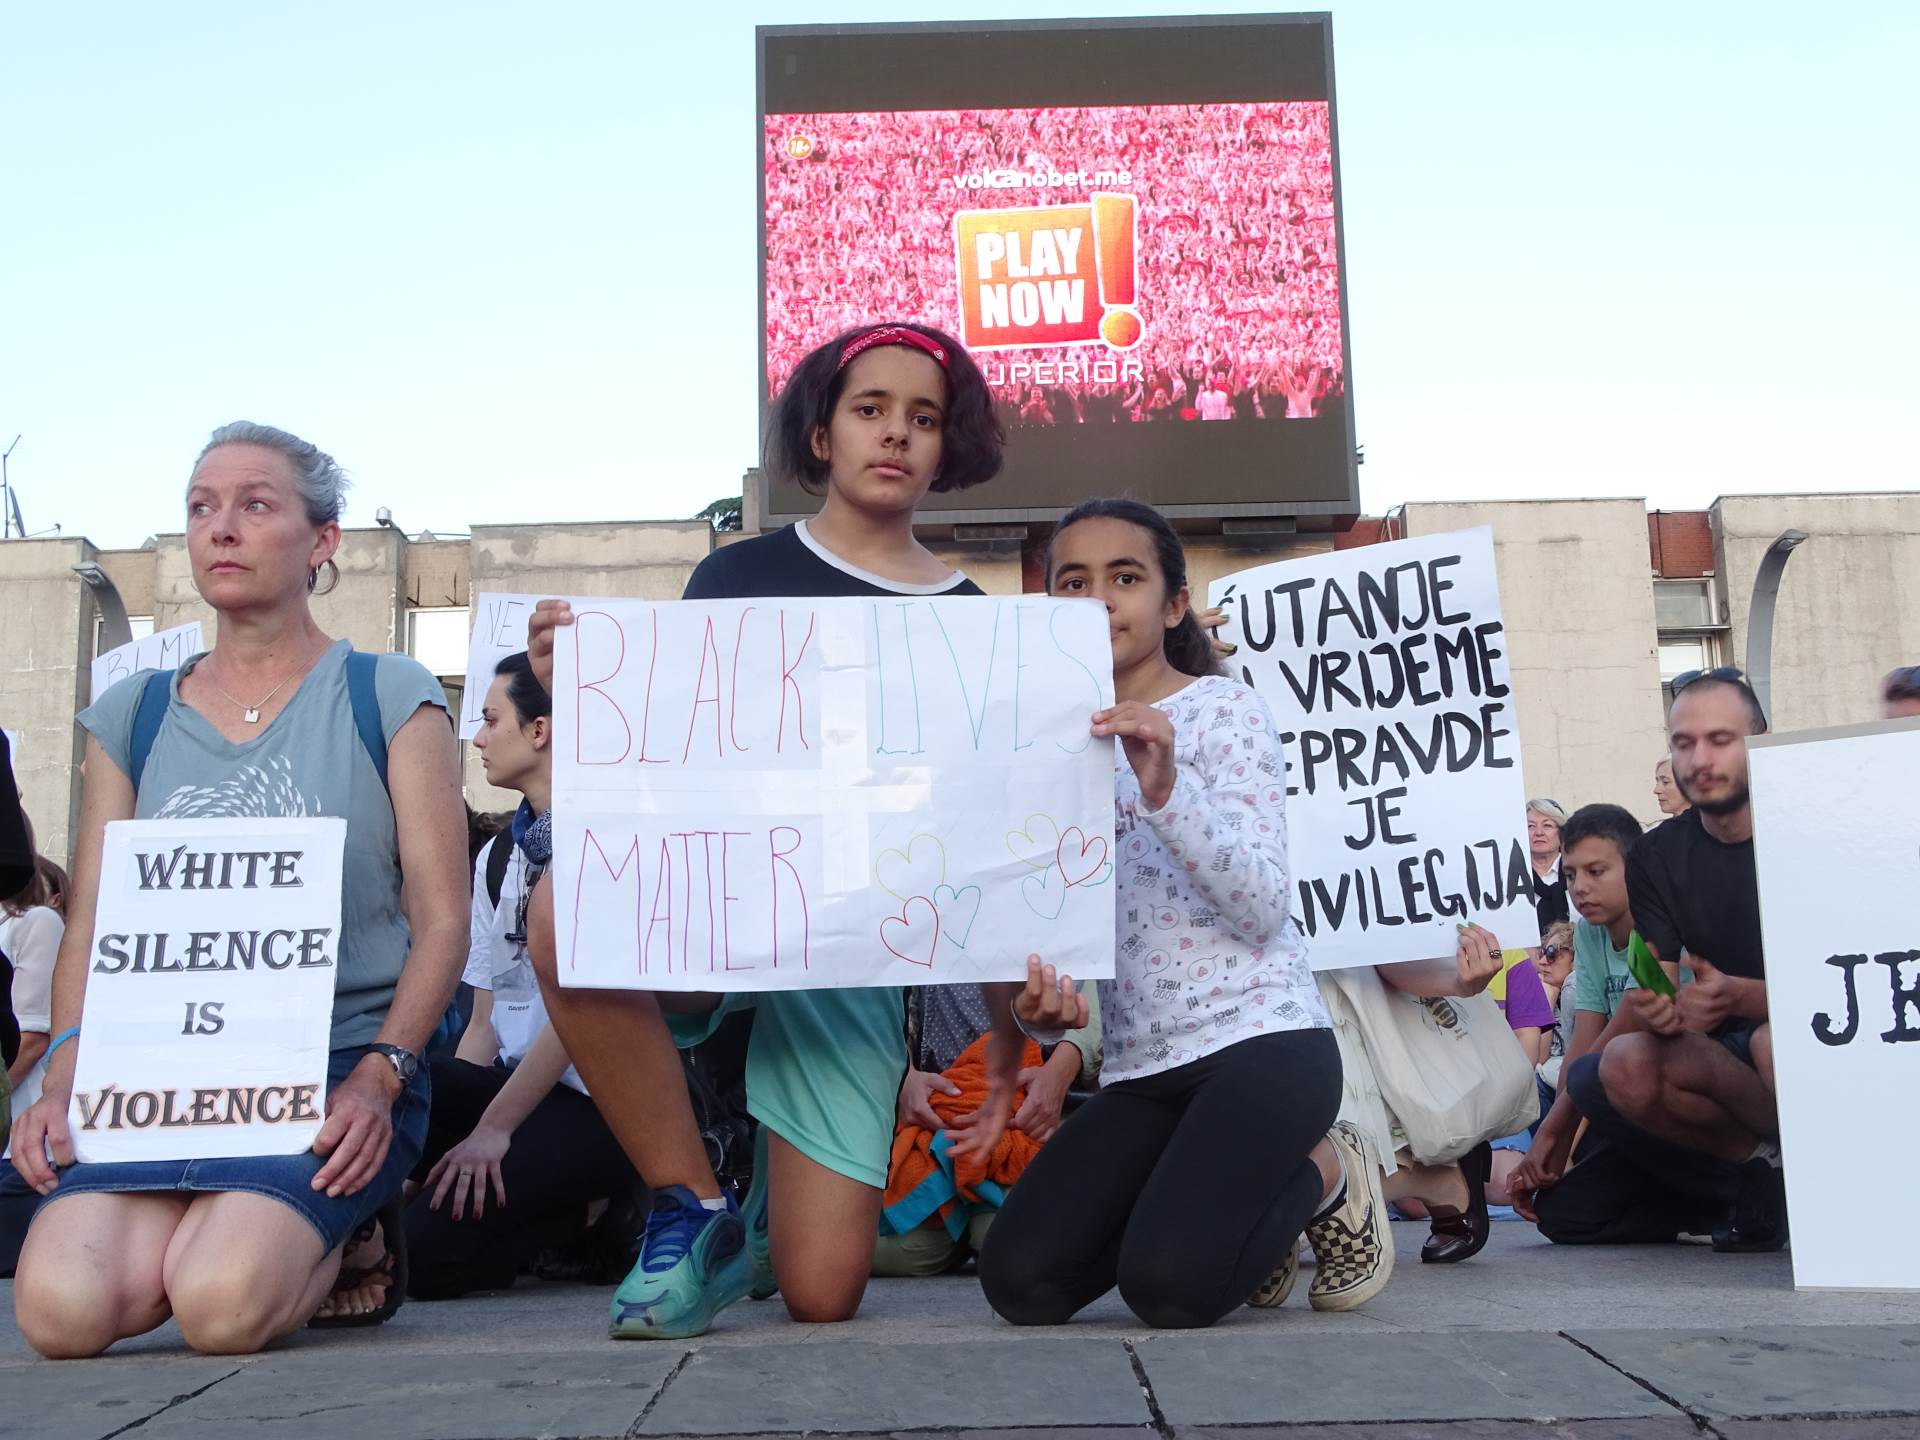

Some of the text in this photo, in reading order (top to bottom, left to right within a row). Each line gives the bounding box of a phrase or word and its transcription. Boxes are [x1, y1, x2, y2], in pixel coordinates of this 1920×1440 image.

[953, 165, 1133, 189] volcanobet.me
[975, 228, 1082, 279] PLAY
[980, 279, 1084, 328] NOW
[983, 360, 1145, 385] UPERIOR
[576, 607, 814, 765] BLACK
[875, 602, 1102, 755] LIVES
[1279, 621, 1510, 713] VRIJEME
[1242, 736, 1255, 750] HI
[1280, 702, 1514, 795] EPRAVDE
[1344, 787, 1417, 850] JE
[136, 844, 304, 890] WHITE
[571, 826, 809, 975] MATTER
[1290, 838, 1536, 938] IVILEGIJA
[1128, 908, 1138, 923] HI
[1189, 917, 1216, 928] VIBES
[93, 927, 334, 974] SILENCE
[1225, 955, 1238, 969] HI
[1153, 989, 1178, 1001] GOOD
[1156, 979, 1181, 991] VIBES
[1186, 996, 1200, 1011] HI
[181, 1001, 225, 1035] IS
[1150, 1020, 1161, 1034] HI
[1213, 1006, 1241, 1020] VIBES
[76, 1082, 320, 1131] VIOLENCE
